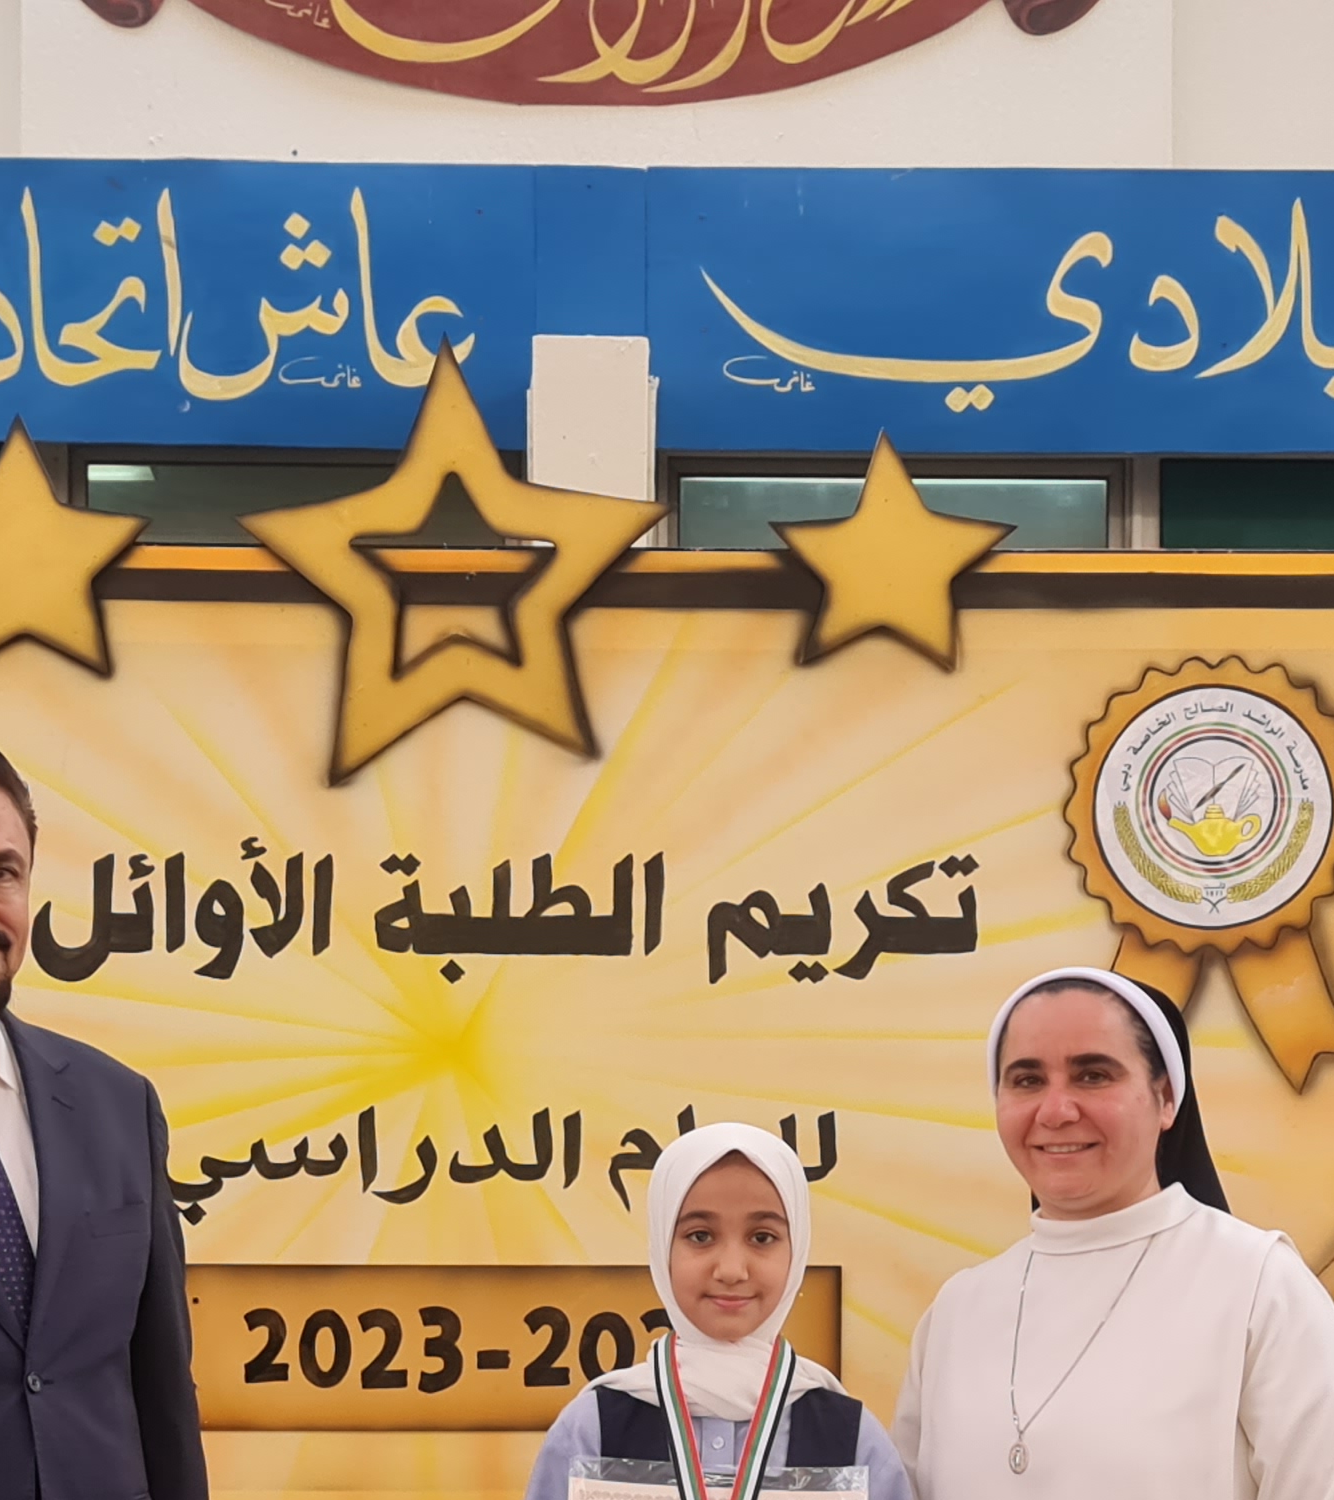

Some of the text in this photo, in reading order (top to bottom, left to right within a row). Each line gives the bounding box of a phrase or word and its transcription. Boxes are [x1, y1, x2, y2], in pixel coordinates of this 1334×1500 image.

[180, 190, 476, 401] عاش
[1127, 712, 1177, 756] الخاصة
[1242, 709, 1285, 740] الراشد
[1120, 763, 1132, 792] دبي
[1285, 740, 1310, 791] مدرسة
[30, 836, 980, 986] تكريم الطلبة الأوائل
[168, 1103, 839, 1226] للم الدراسي
[242, 1305, 676, 1395] 2023-20
